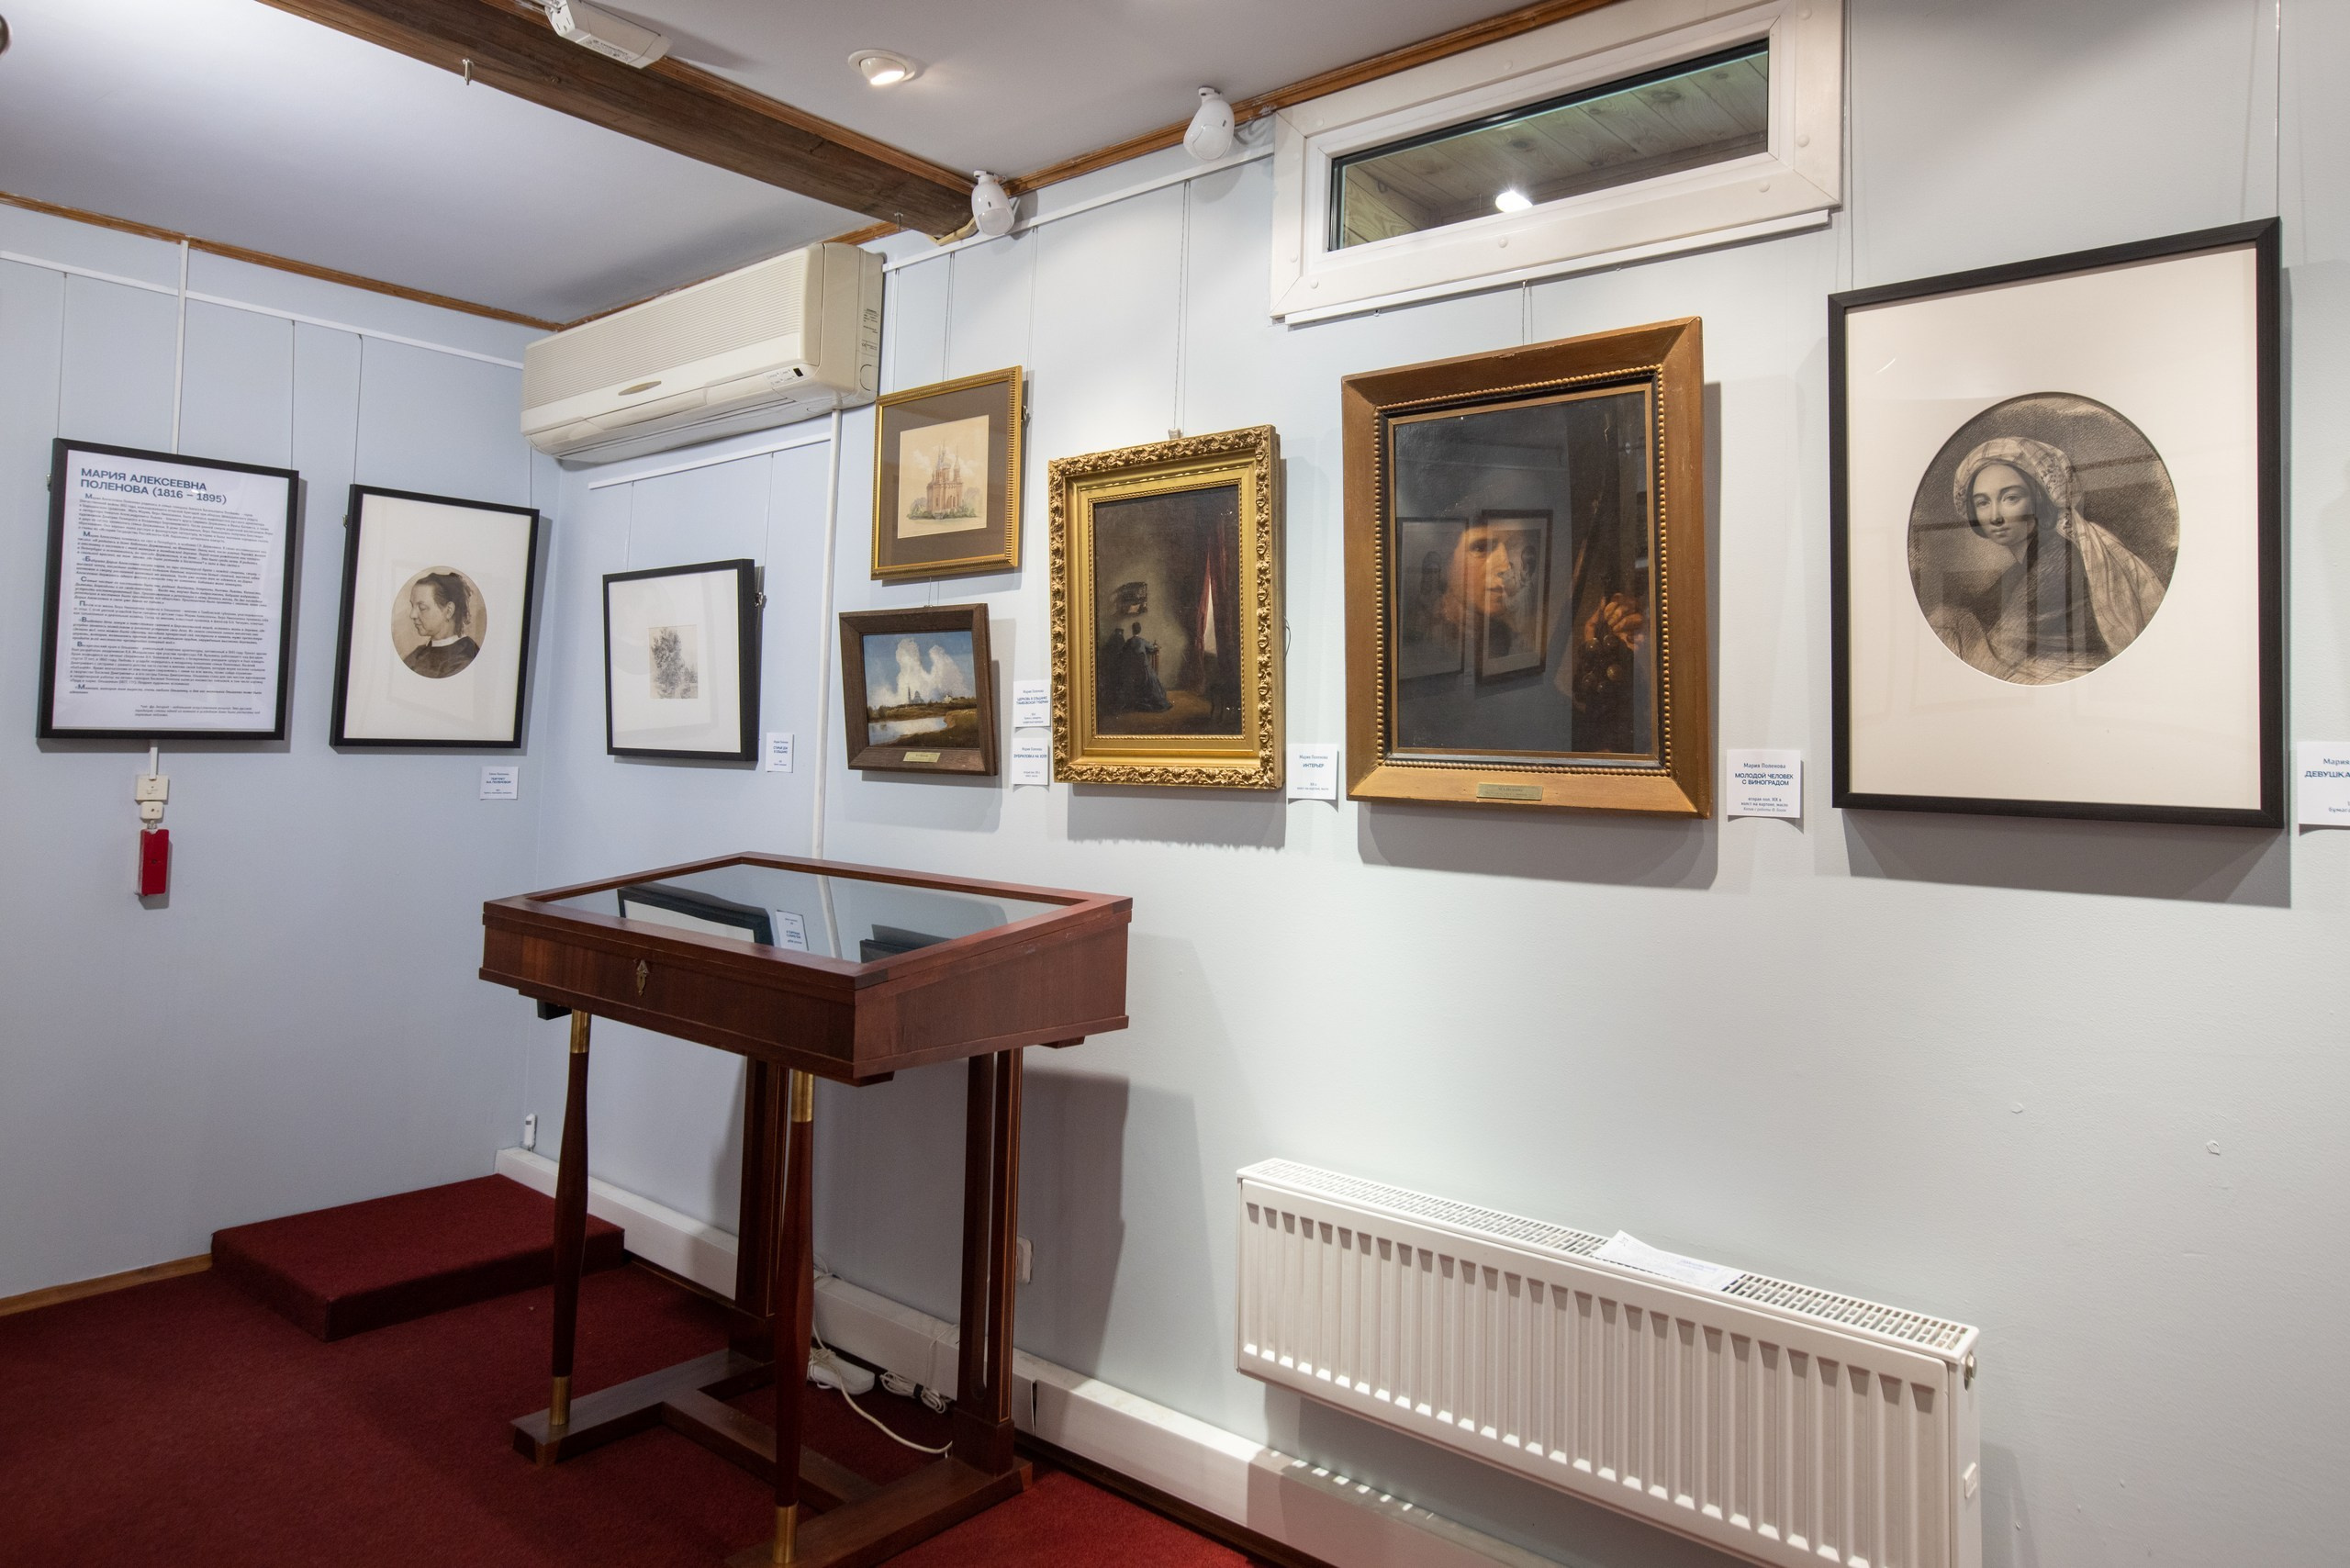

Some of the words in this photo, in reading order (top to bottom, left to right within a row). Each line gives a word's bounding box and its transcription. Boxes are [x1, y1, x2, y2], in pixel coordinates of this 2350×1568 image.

[81, 467, 126, 482] МАРИЯ
[129, 474, 207, 491] АЛЕКСЕЕВНА
[80, 479, 149, 495] ПОЛЕНОВА
[152, 487, 184, 499] (1816
[196, 492, 228, 505] 1895)
